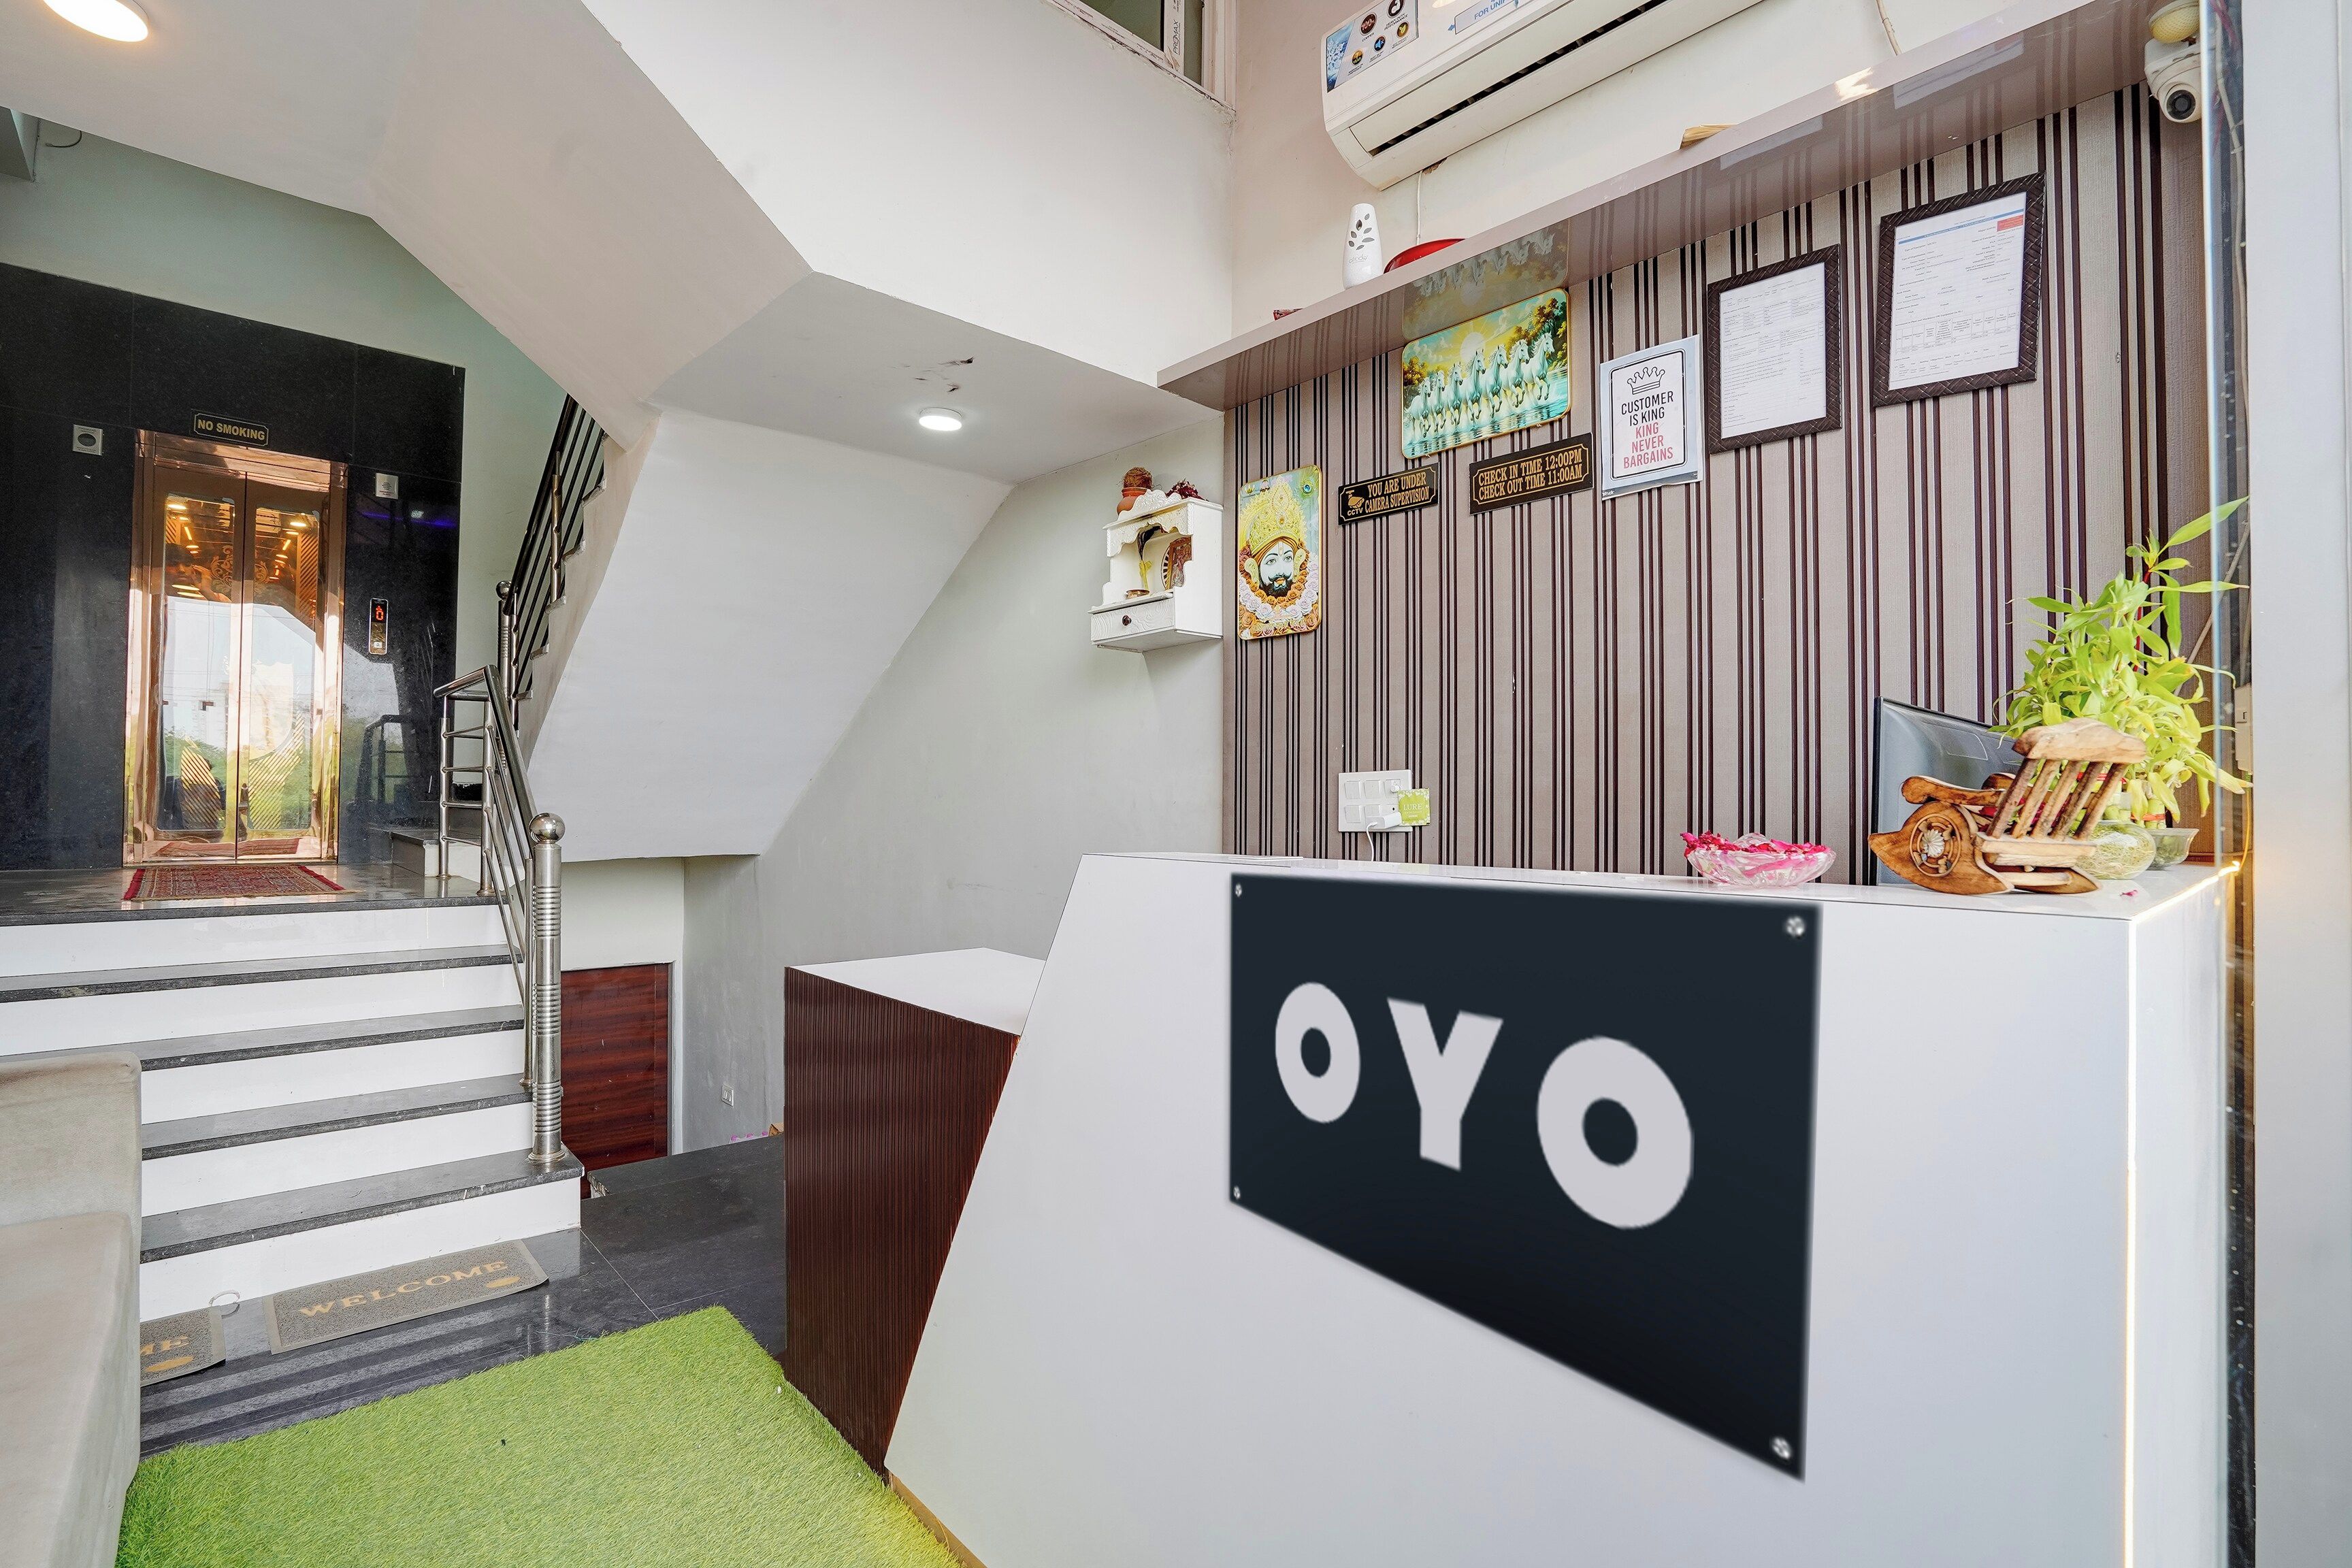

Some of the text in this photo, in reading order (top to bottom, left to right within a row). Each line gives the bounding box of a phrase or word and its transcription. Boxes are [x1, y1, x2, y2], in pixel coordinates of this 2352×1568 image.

[1474, 7, 1489, 20] FOR
[1621, 391, 1674, 415] CUSTOMER
[1629, 406, 1665, 427] IS KING
[197, 419, 265, 441] NO SMOKING
[1635, 422, 1659, 439] KING
[1631, 435, 1664, 454] NEVER
[1478, 448, 1582, 487] CHECK IN TIME 12:00PM
[1623, 446, 1674, 469] BARGAINS
[1367, 471, 1426, 497] YOU ARE UNDER
[1478, 463, 1582, 501] CHECK OUT TIME 11:00AM
[1365, 486, 1430, 513] CAMERA SUPERVISION
[1347, 507, 1363, 517] CCTV
[1275, 981, 1693, 1229] OYO
[299, 1260, 509, 1317] WELCOME
